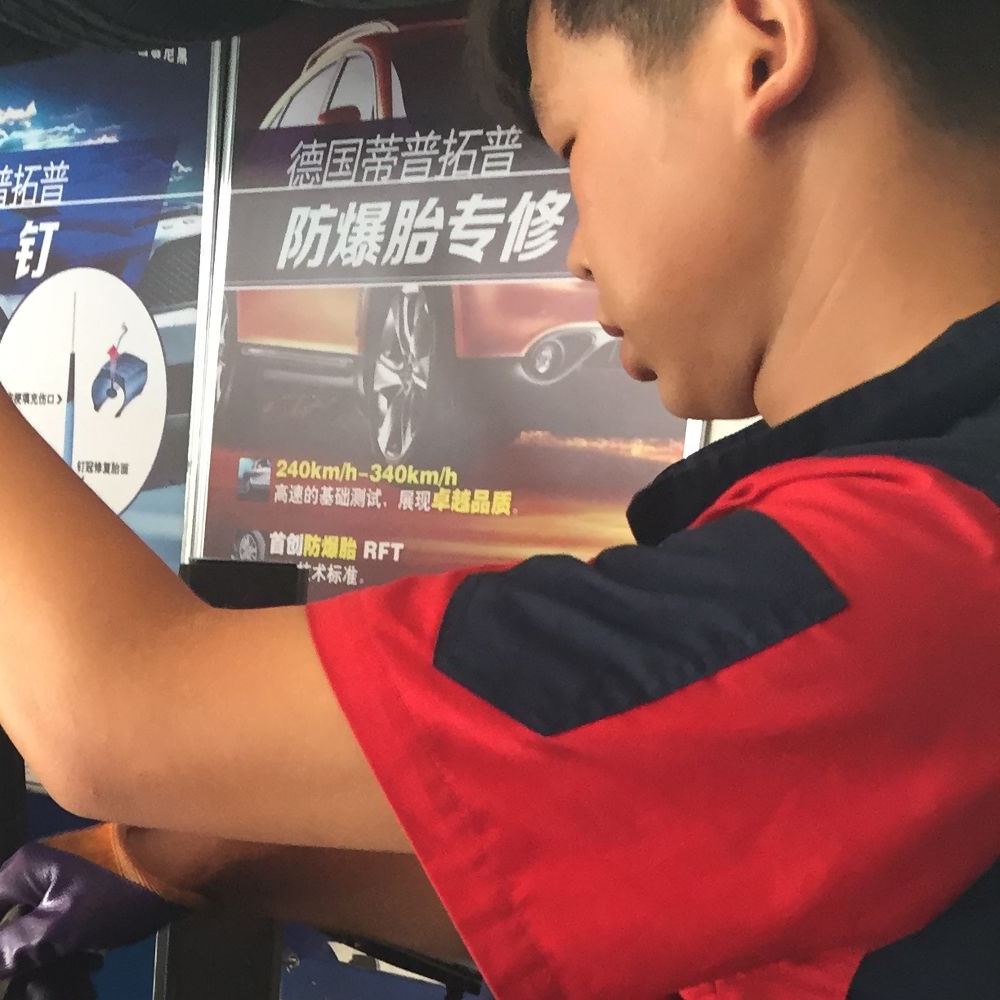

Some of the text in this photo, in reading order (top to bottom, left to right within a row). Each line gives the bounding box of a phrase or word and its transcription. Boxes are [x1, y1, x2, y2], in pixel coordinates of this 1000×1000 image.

[287, 124, 523, 187] 德国蒂普拓普
[276, 189, 571, 270] 防爆胎专修
[363, 540, 405, 562] RFT
